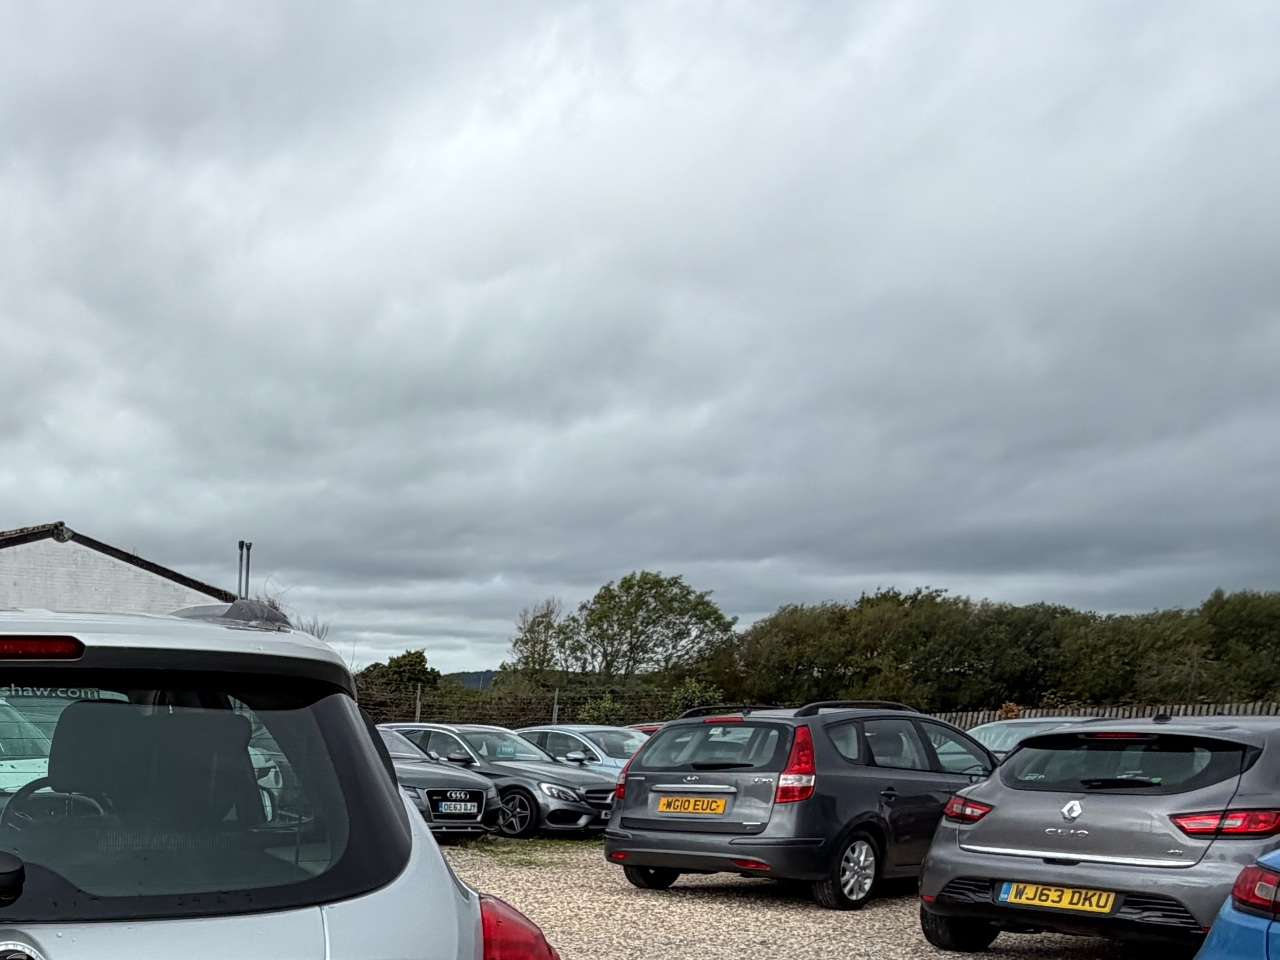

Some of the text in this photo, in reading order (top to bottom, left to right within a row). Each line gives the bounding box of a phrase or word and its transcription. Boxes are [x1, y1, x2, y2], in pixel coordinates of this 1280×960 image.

[665, 798, 718, 812] WG10 EUC
[1014, 884, 1111, 909] WJ63 DKU
